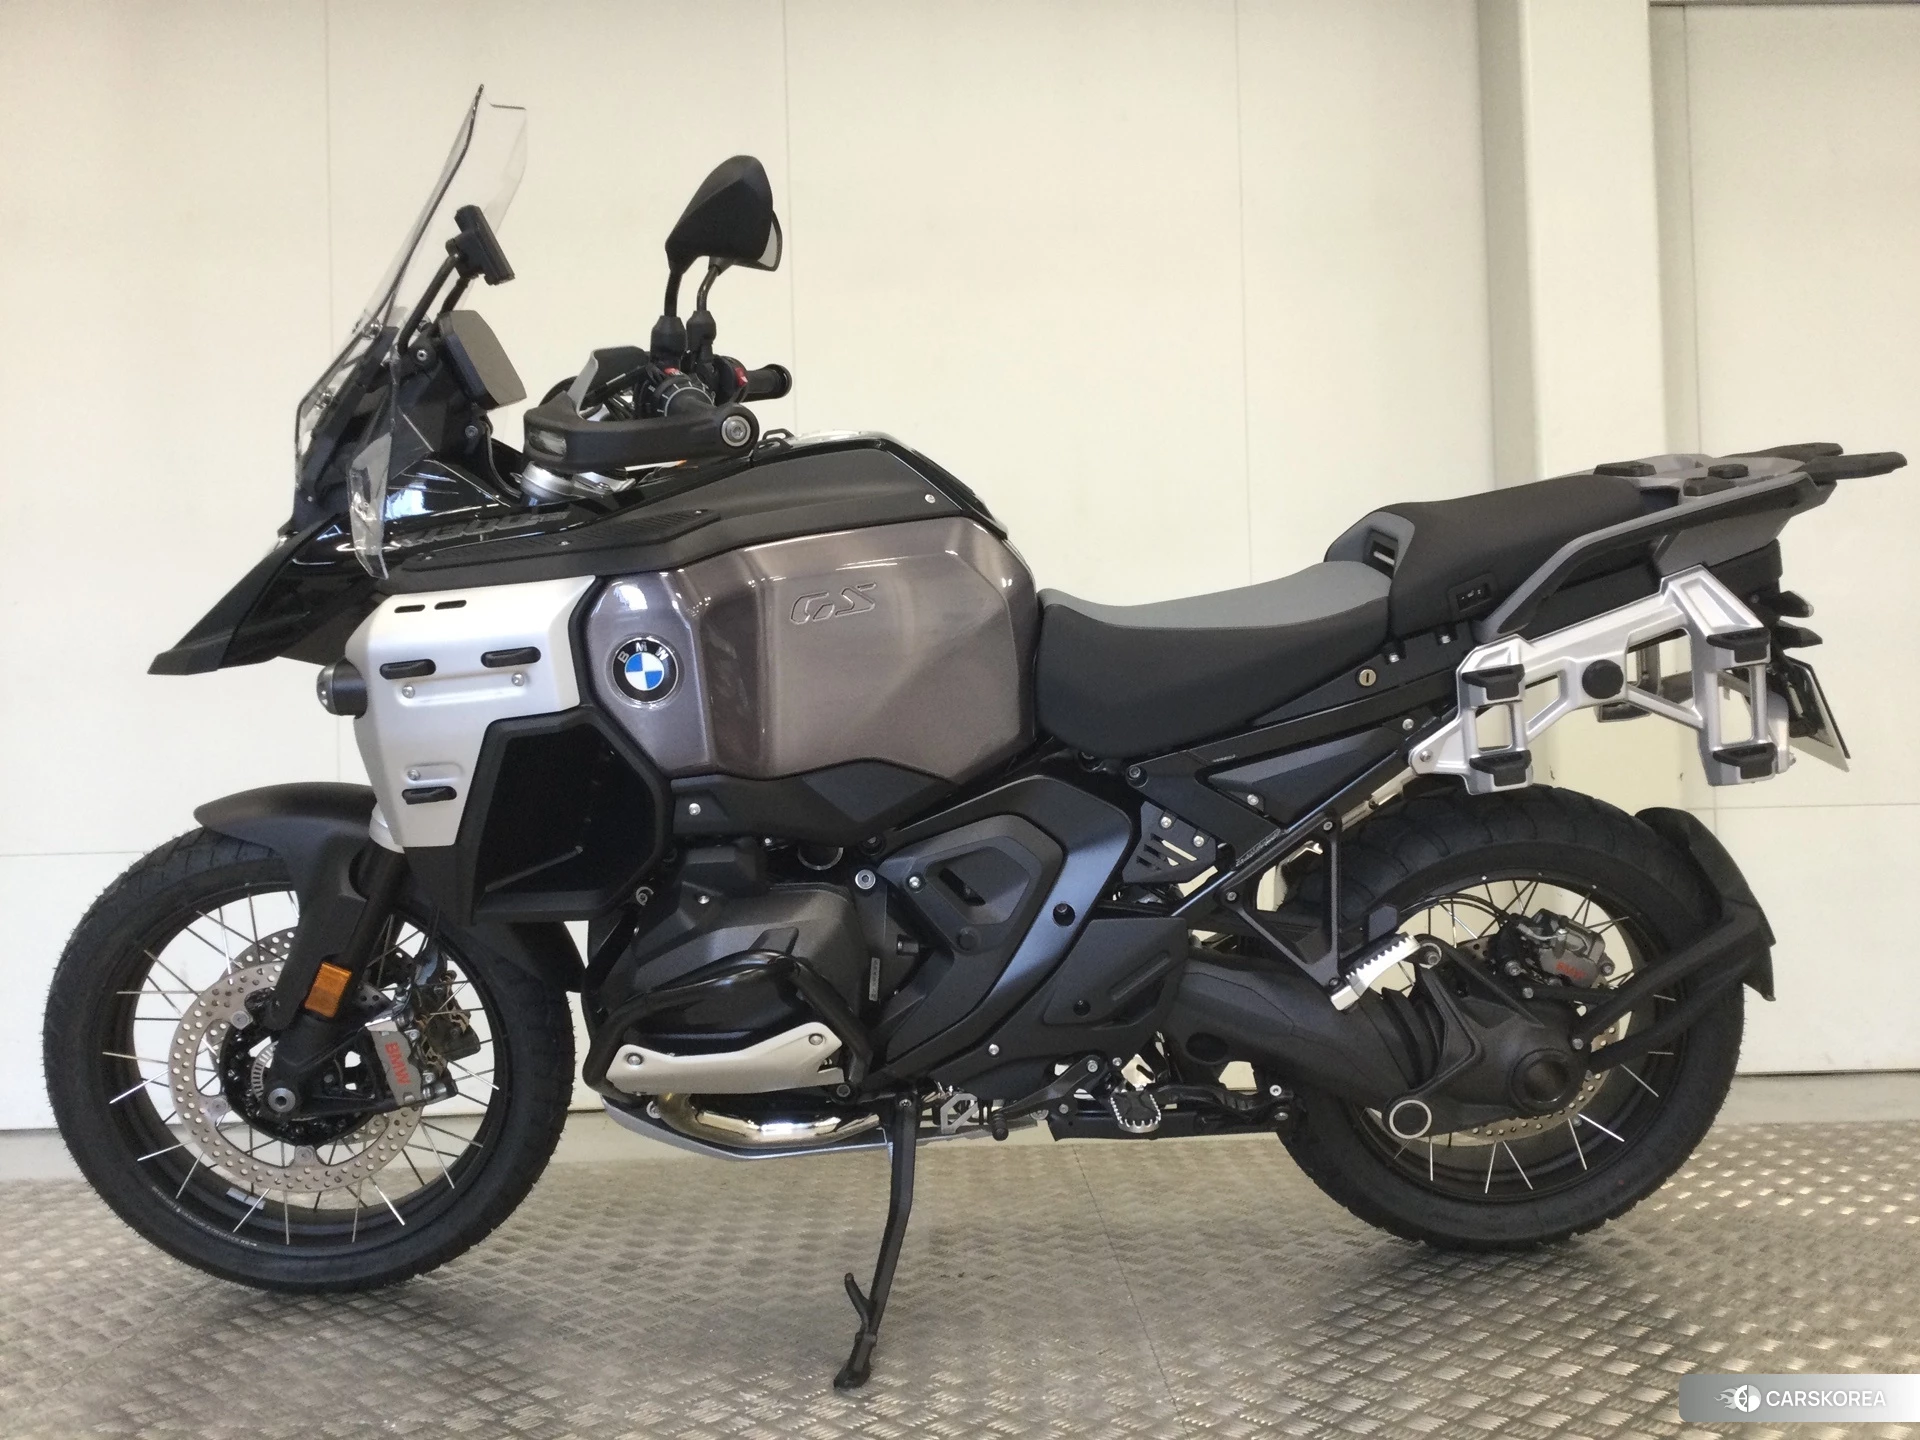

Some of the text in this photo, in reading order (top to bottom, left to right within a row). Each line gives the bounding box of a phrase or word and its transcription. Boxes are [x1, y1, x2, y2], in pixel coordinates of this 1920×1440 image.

[789, 582, 877, 625] GS
[617, 641, 669, 663] BMW
[384, 1042, 412, 1085] BMW
